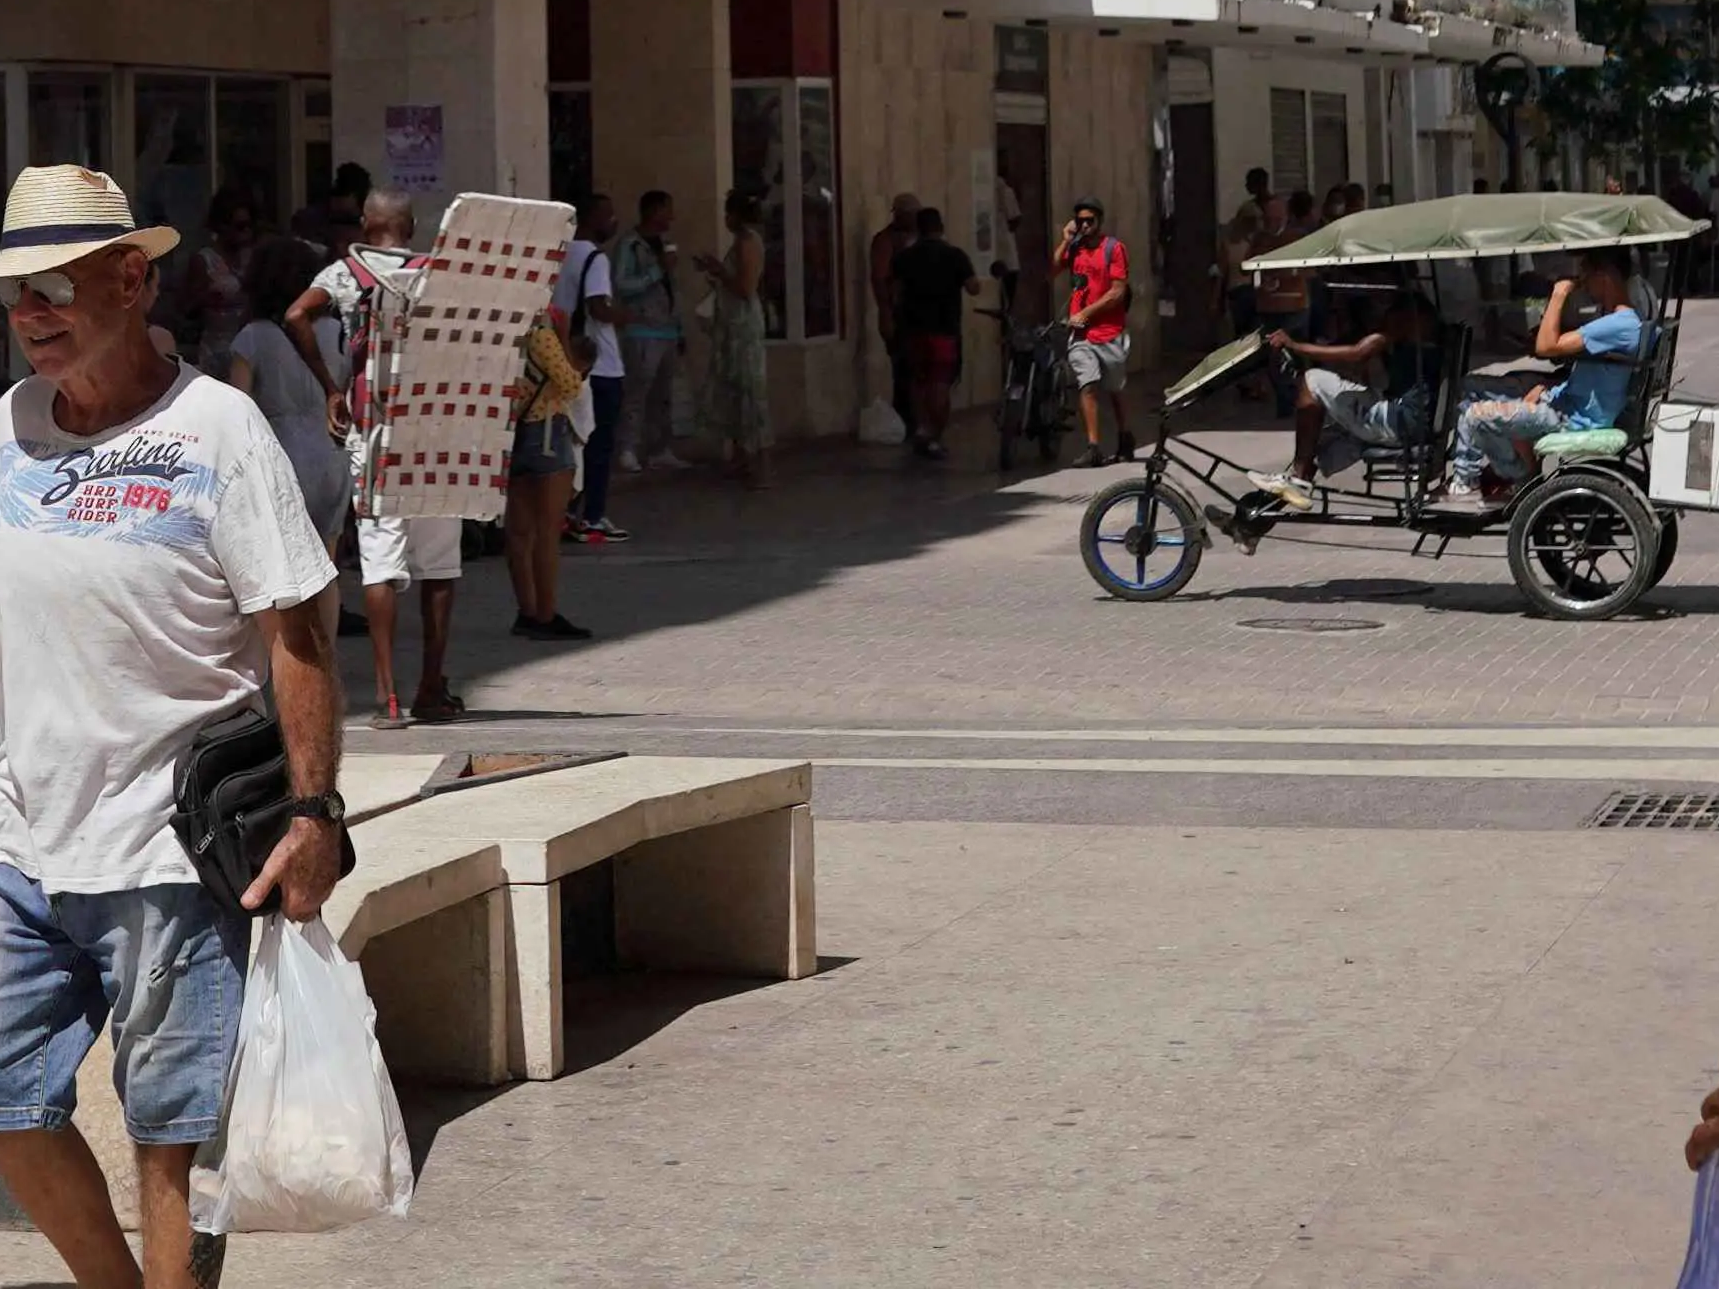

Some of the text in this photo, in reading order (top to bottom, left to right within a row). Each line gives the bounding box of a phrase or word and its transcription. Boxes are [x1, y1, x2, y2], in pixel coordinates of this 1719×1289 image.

[41, 436, 196, 505] Surfing
[83, 485, 117, 498] HRD
[75, 497, 118, 510] SURF
[67, 508, 118, 523] RIDER
